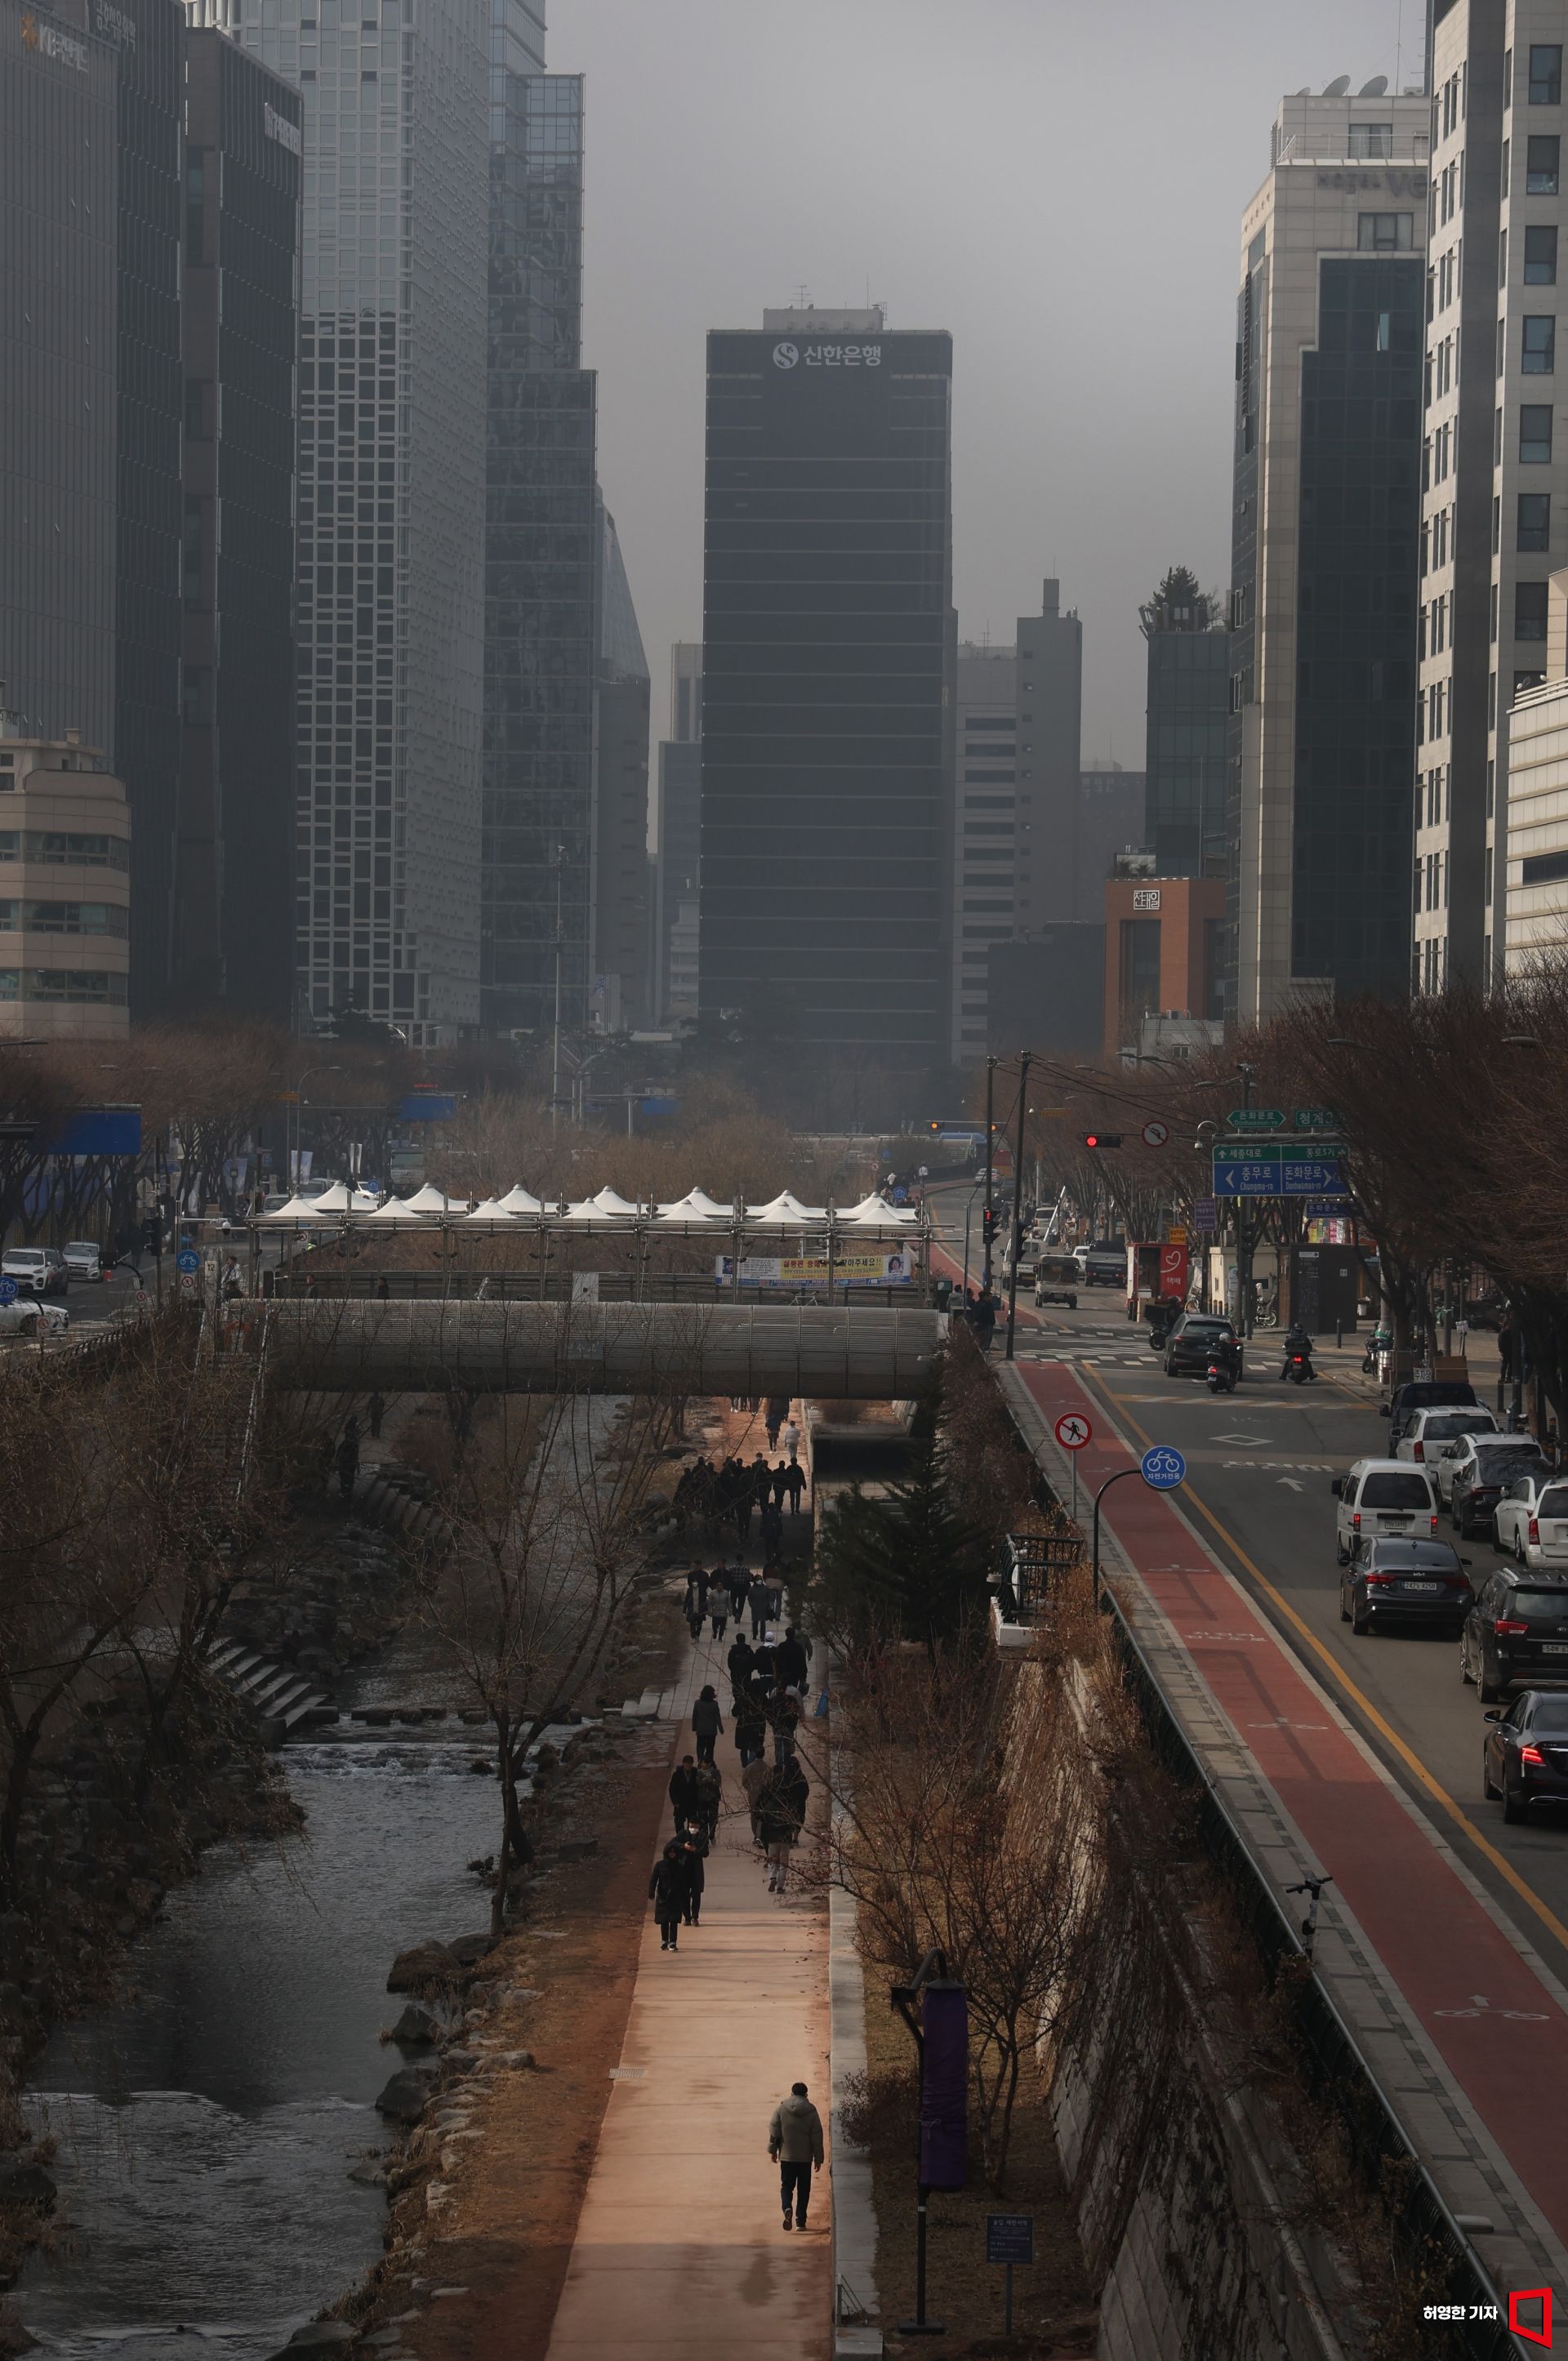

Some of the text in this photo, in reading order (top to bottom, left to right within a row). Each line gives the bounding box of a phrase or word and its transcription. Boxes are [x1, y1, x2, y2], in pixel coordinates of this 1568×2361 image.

[804, 345, 881, 366] 신한은행
[1133, 889, 1160, 911] 전태일
[1239, 1111, 1275, 1120] 돈화문로
[1229, 1148, 1262, 1159] 세종대로
[1241, 1166, 1272, 1182] 충무로
[1285, 1165, 1322, 1180] 돈화문로
[1240, 1182, 1273, 1192] Chungmu-ro
[1285, 1181, 1321, 1190] Donhwamun-ro
[1166, 1277, 1181, 1285] 택배
